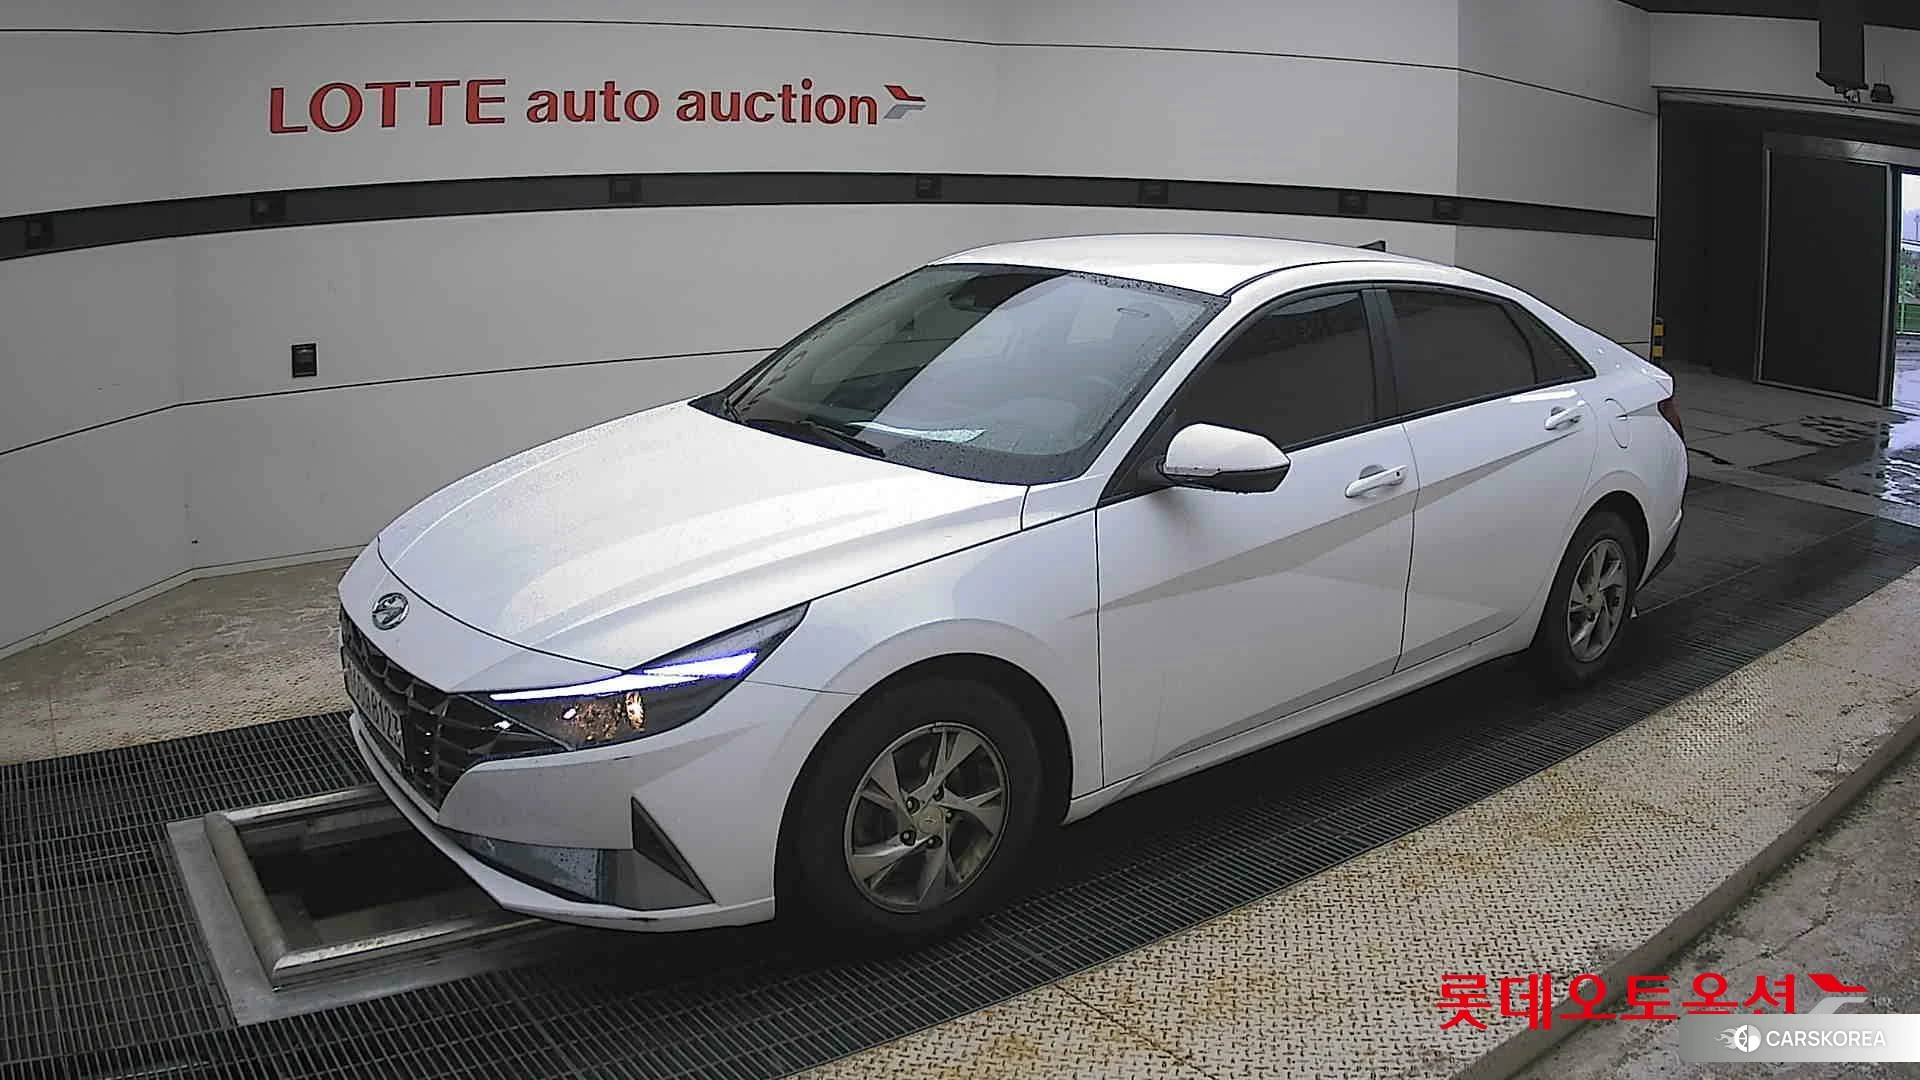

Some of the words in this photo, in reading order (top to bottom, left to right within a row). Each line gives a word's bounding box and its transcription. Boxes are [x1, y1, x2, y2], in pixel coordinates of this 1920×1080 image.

[270, 79, 506, 134] LOTTE
[527, 81, 660, 123] auto
[676, 78, 878, 125] auction
